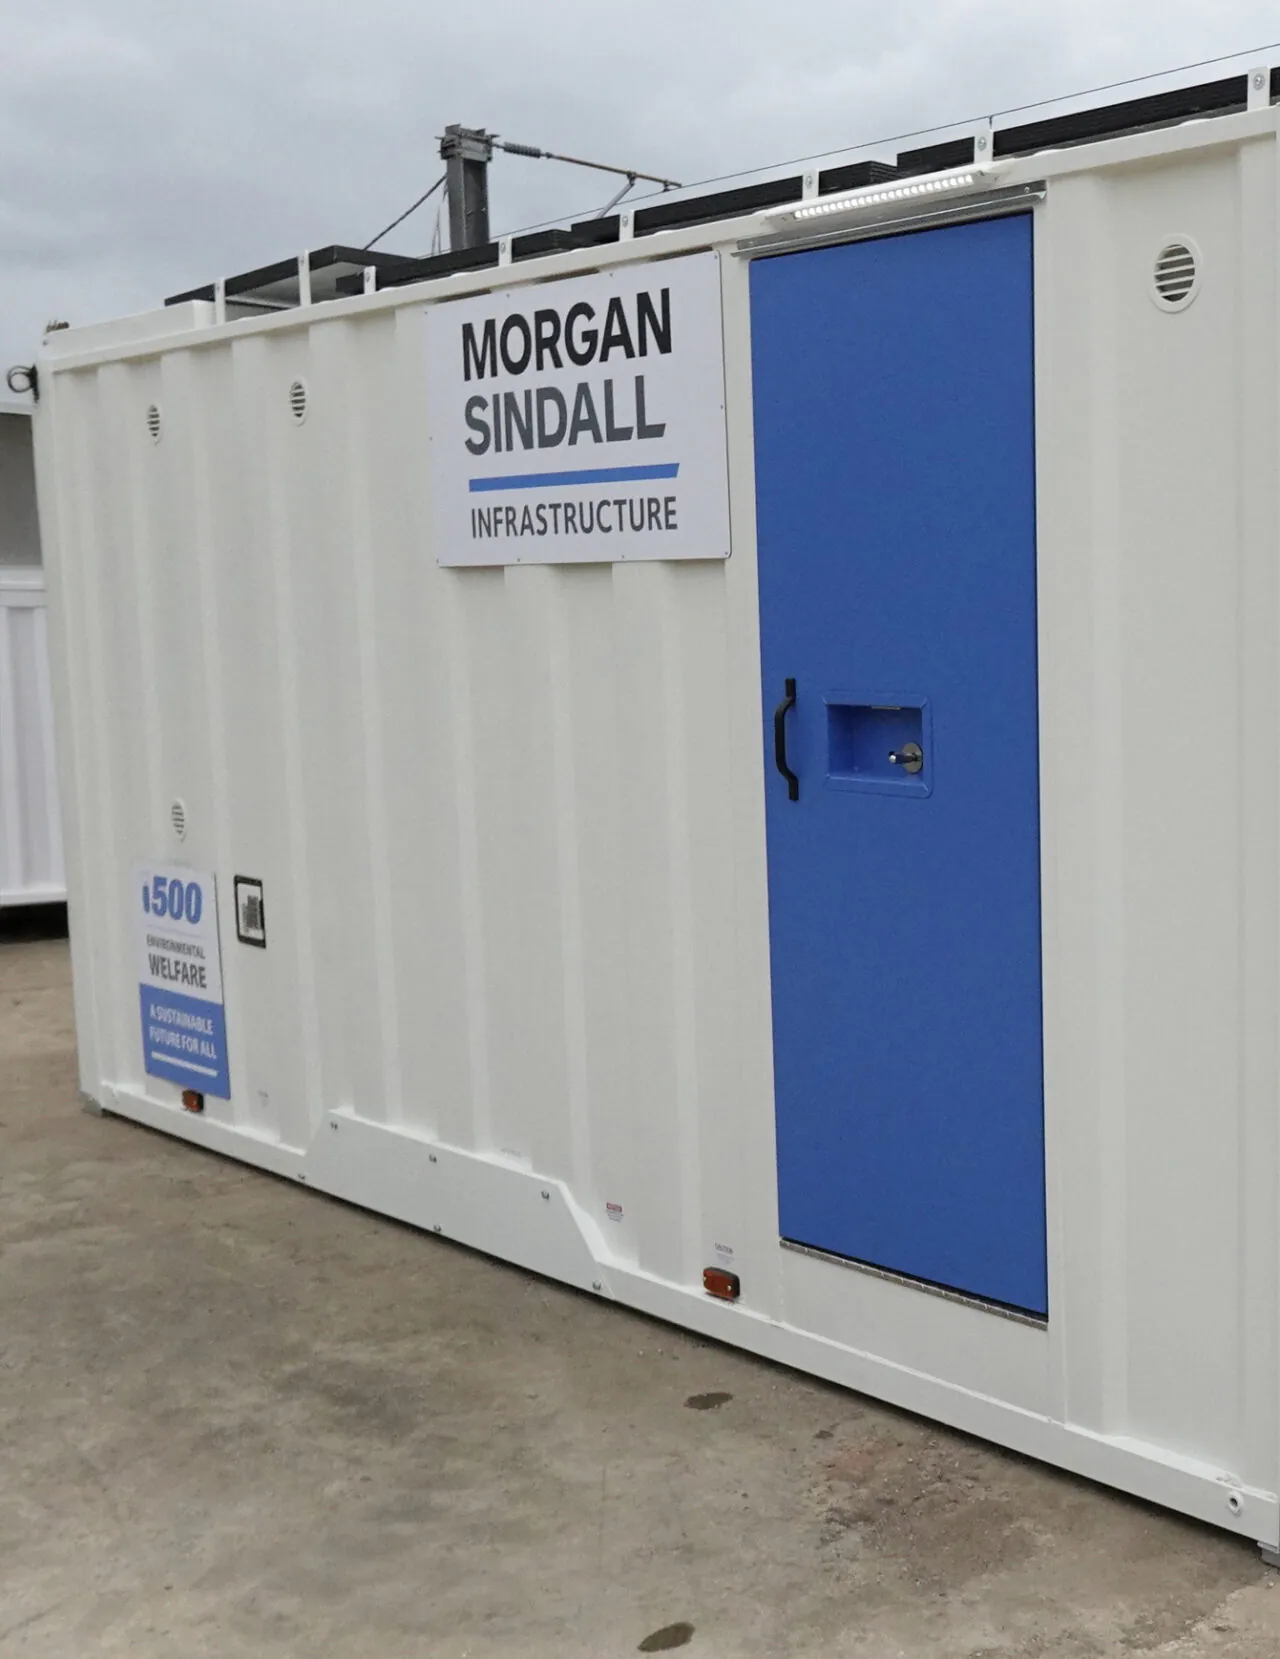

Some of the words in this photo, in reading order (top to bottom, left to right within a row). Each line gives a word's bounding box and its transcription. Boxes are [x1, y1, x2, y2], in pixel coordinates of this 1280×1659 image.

[462, 287, 672, 382] MORGAN
[464, 374, 667, 456] SINDALL
[471, 496, 679, 540] INFRASTRUCTURE
[148, 953, 208, 989] WELFARE
[156, 1005, 214, 1036] SUSTAINABLE
[149, 1025, 181, 1050] FUTURE
[181, 1034, 199, 1056] FOR
[200, 1040, 217, 1060] ALL
